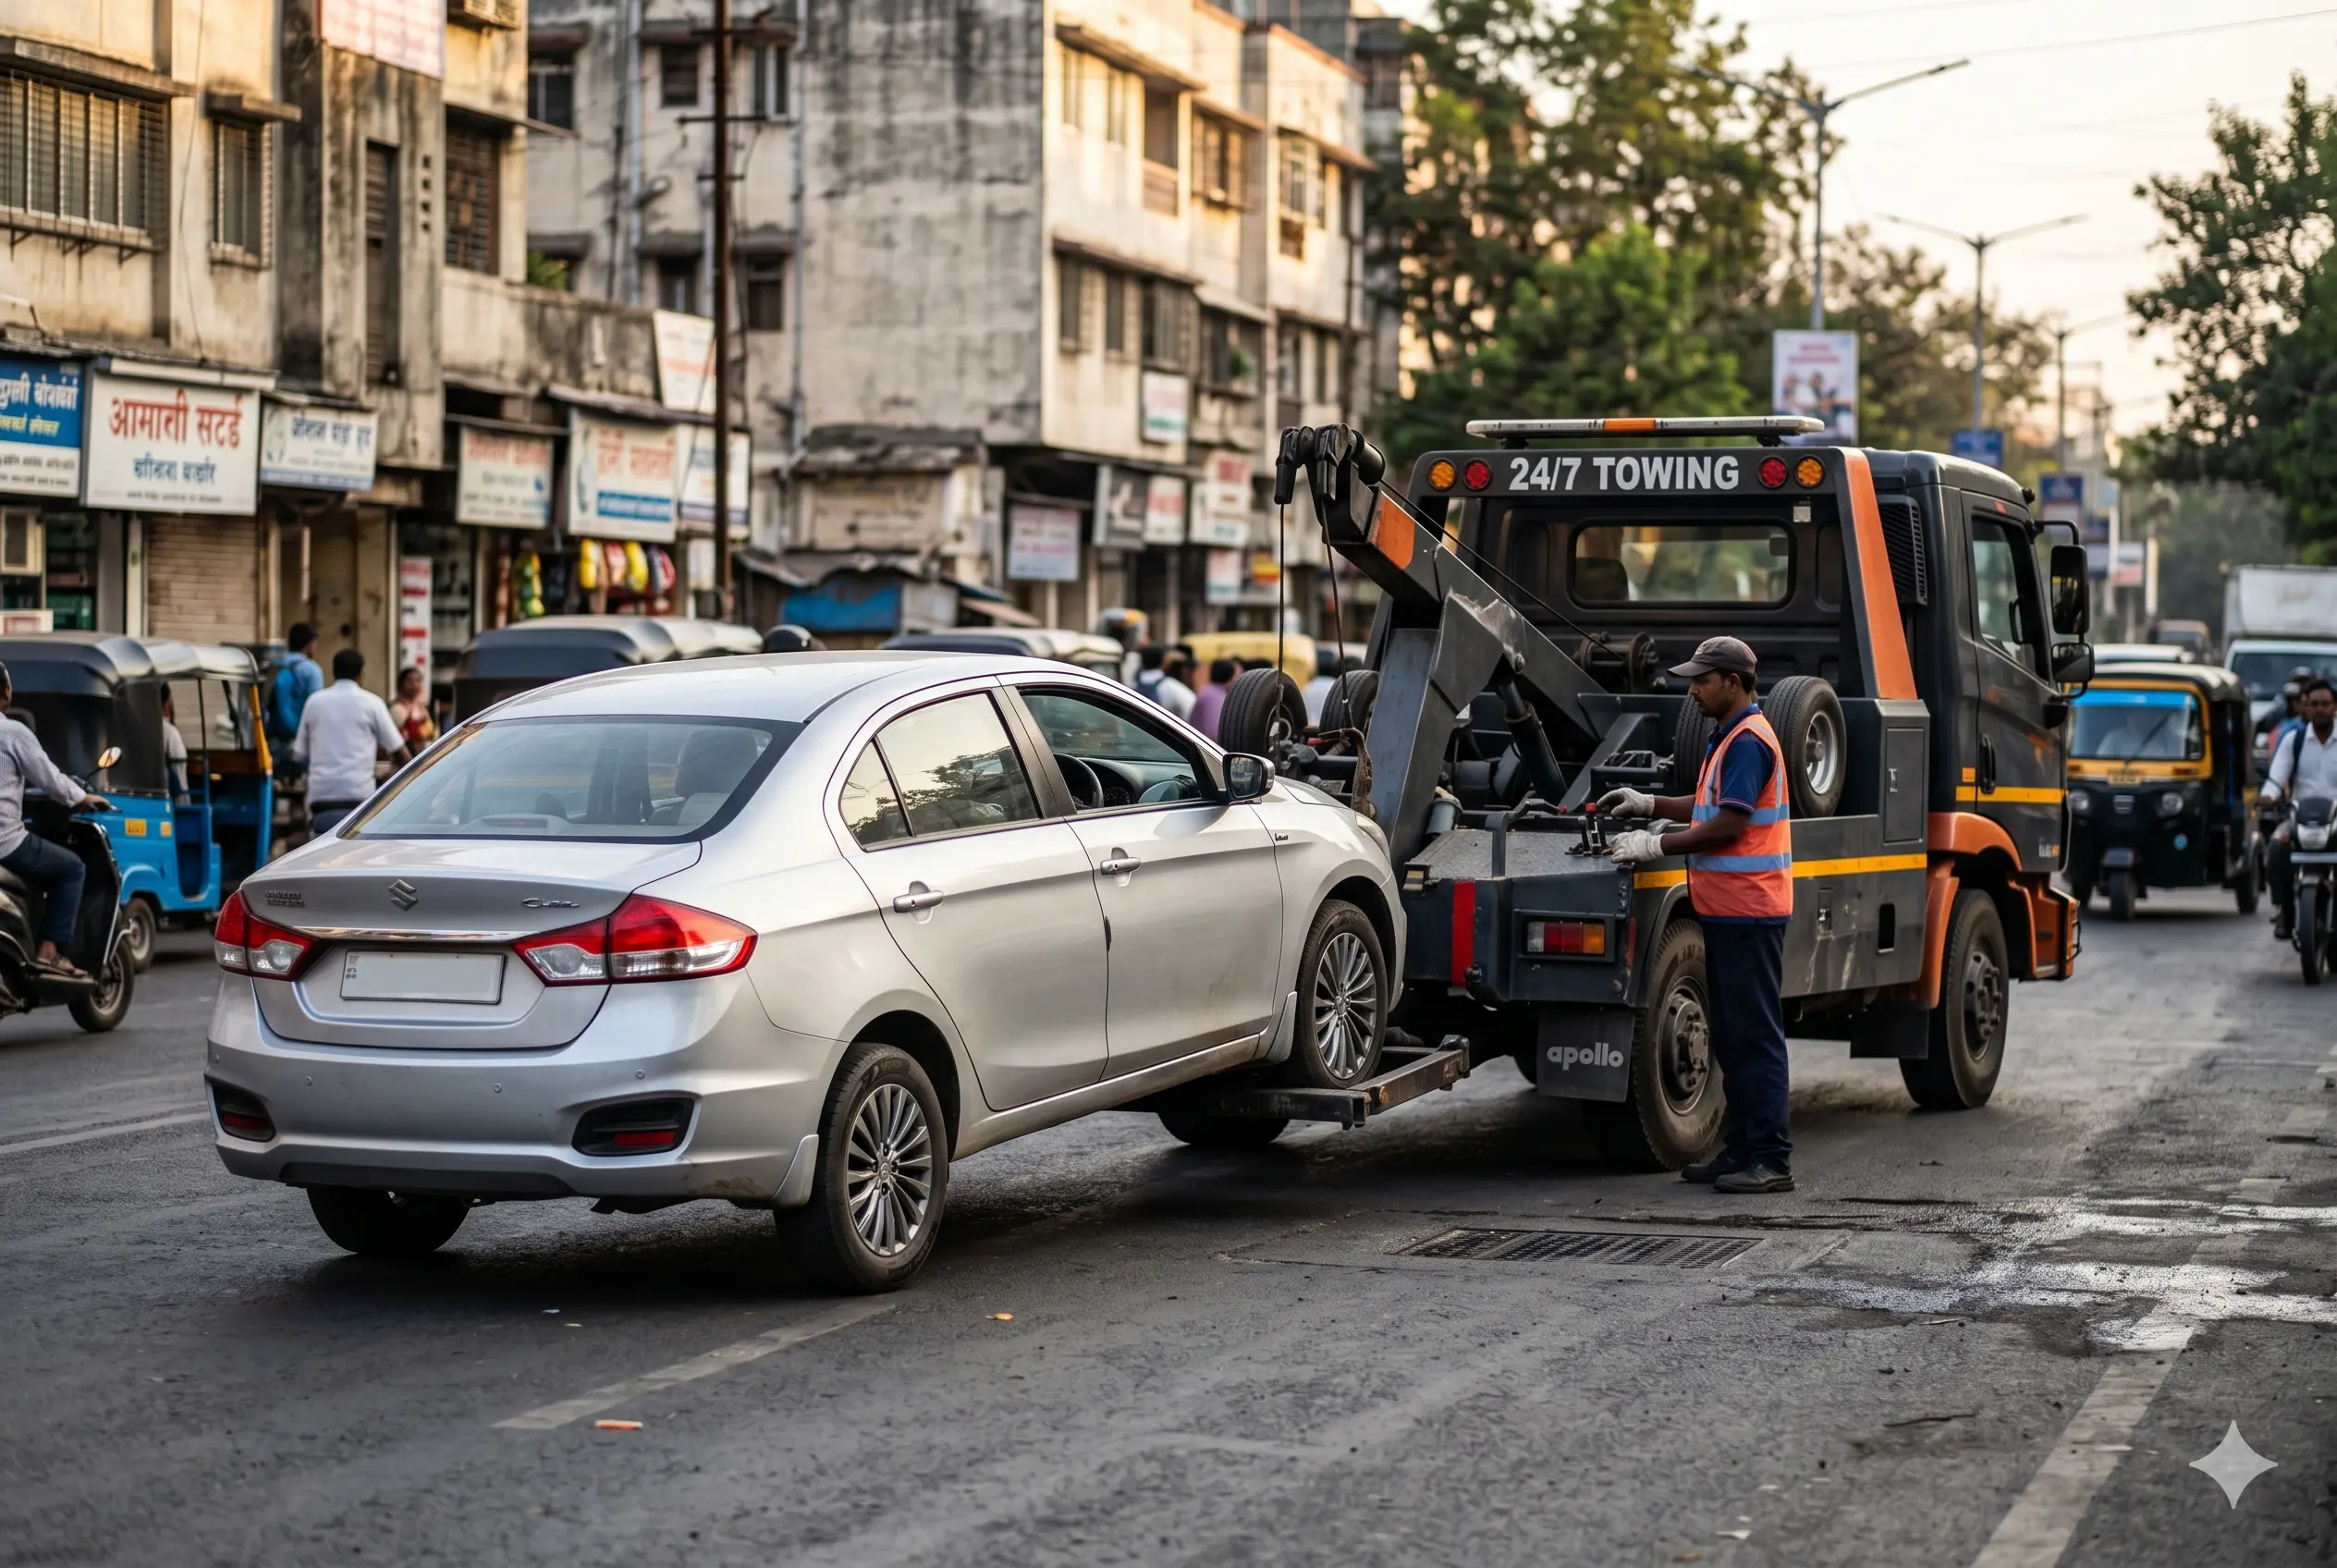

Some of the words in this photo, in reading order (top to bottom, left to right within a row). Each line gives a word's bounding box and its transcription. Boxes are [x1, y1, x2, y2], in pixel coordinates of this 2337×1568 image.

[1509, 457, 1582, 491] 24/7
[1593, 456, 1740, 491] TOWING
[1547, 1042, 1624, 1071] apollo
